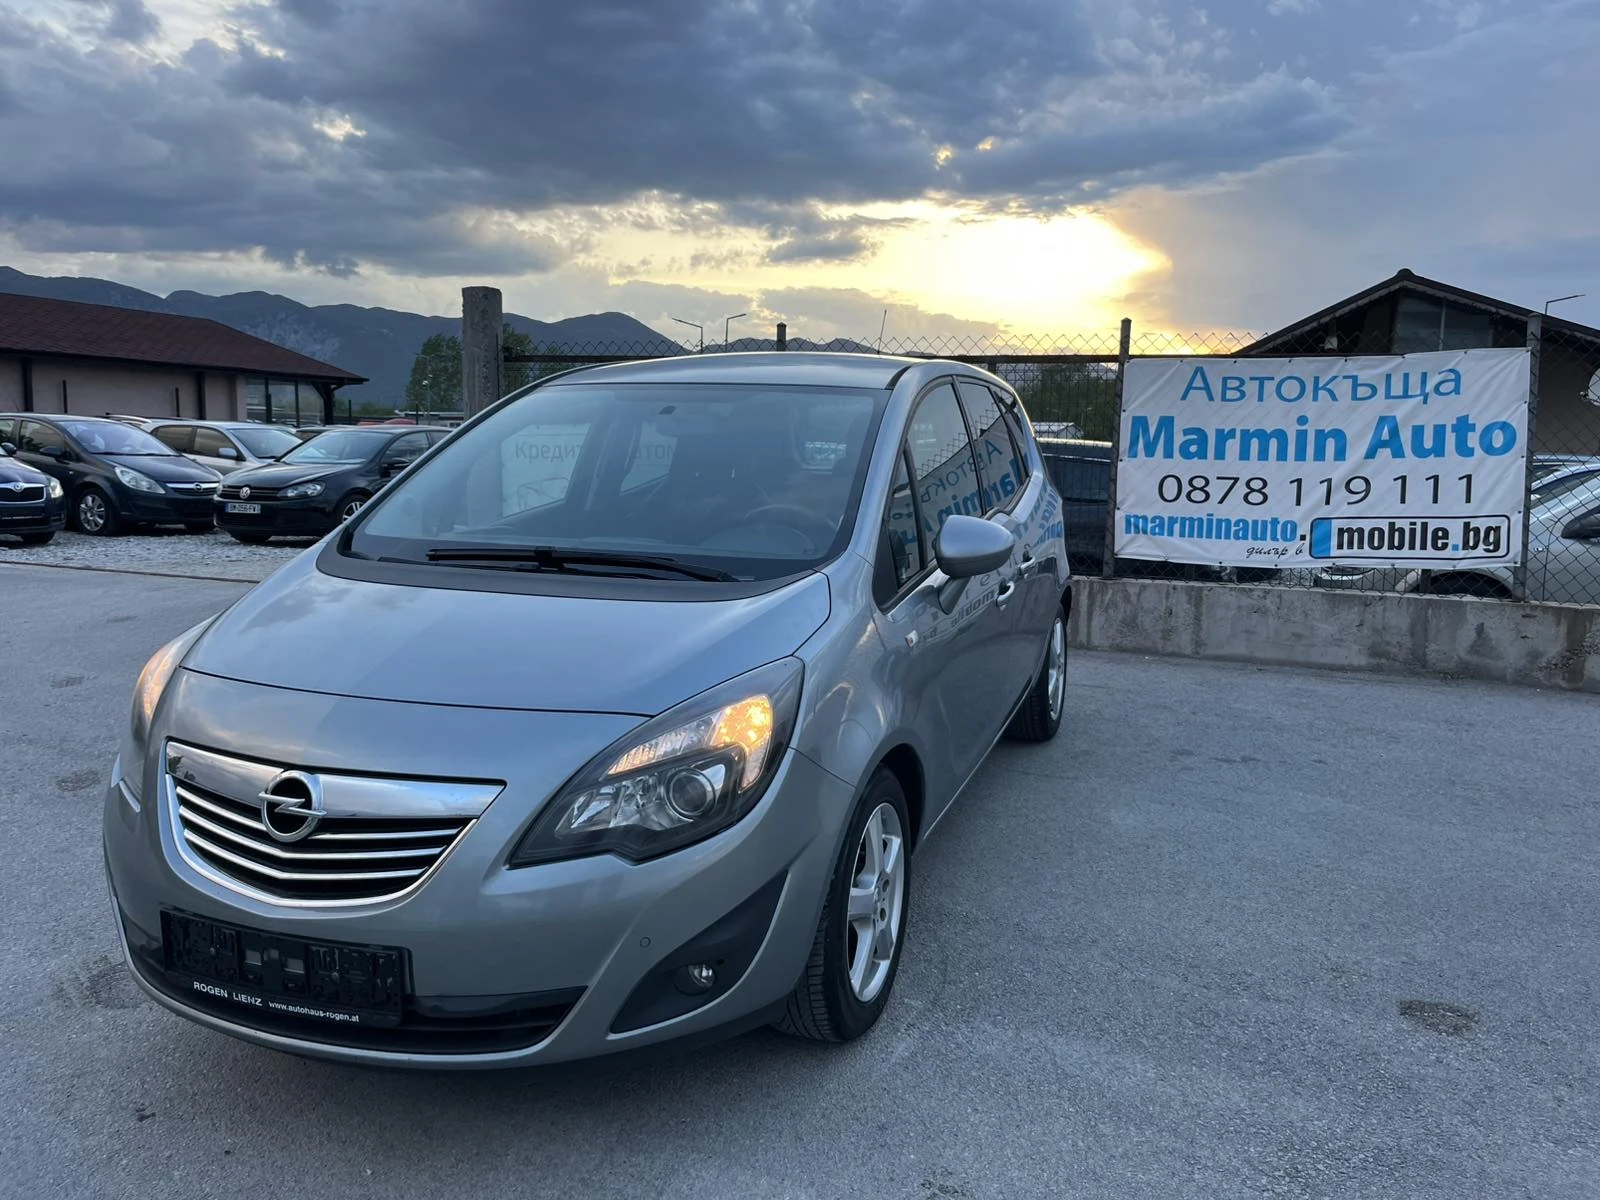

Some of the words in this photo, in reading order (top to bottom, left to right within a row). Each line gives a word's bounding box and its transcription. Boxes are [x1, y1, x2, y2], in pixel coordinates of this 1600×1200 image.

[1181, 366, 1462, 404] Автокъща
[1127, 414, 1348, 462] Marmin
[1363, 414, 1517, 461] Auto
[1158, 474, 1269, 506] 0878
[1290, 475, 1371, 506] 119
[1394, 473, 1473, 504] 111
[1336, 521, 1502, 553] mobile.bg
[193, 981, 228, 998] ROGEN
[233, 992, 263, 1006] LIENZ
[268, 1001, 360, 1023] www.autohaus-rogen.at
